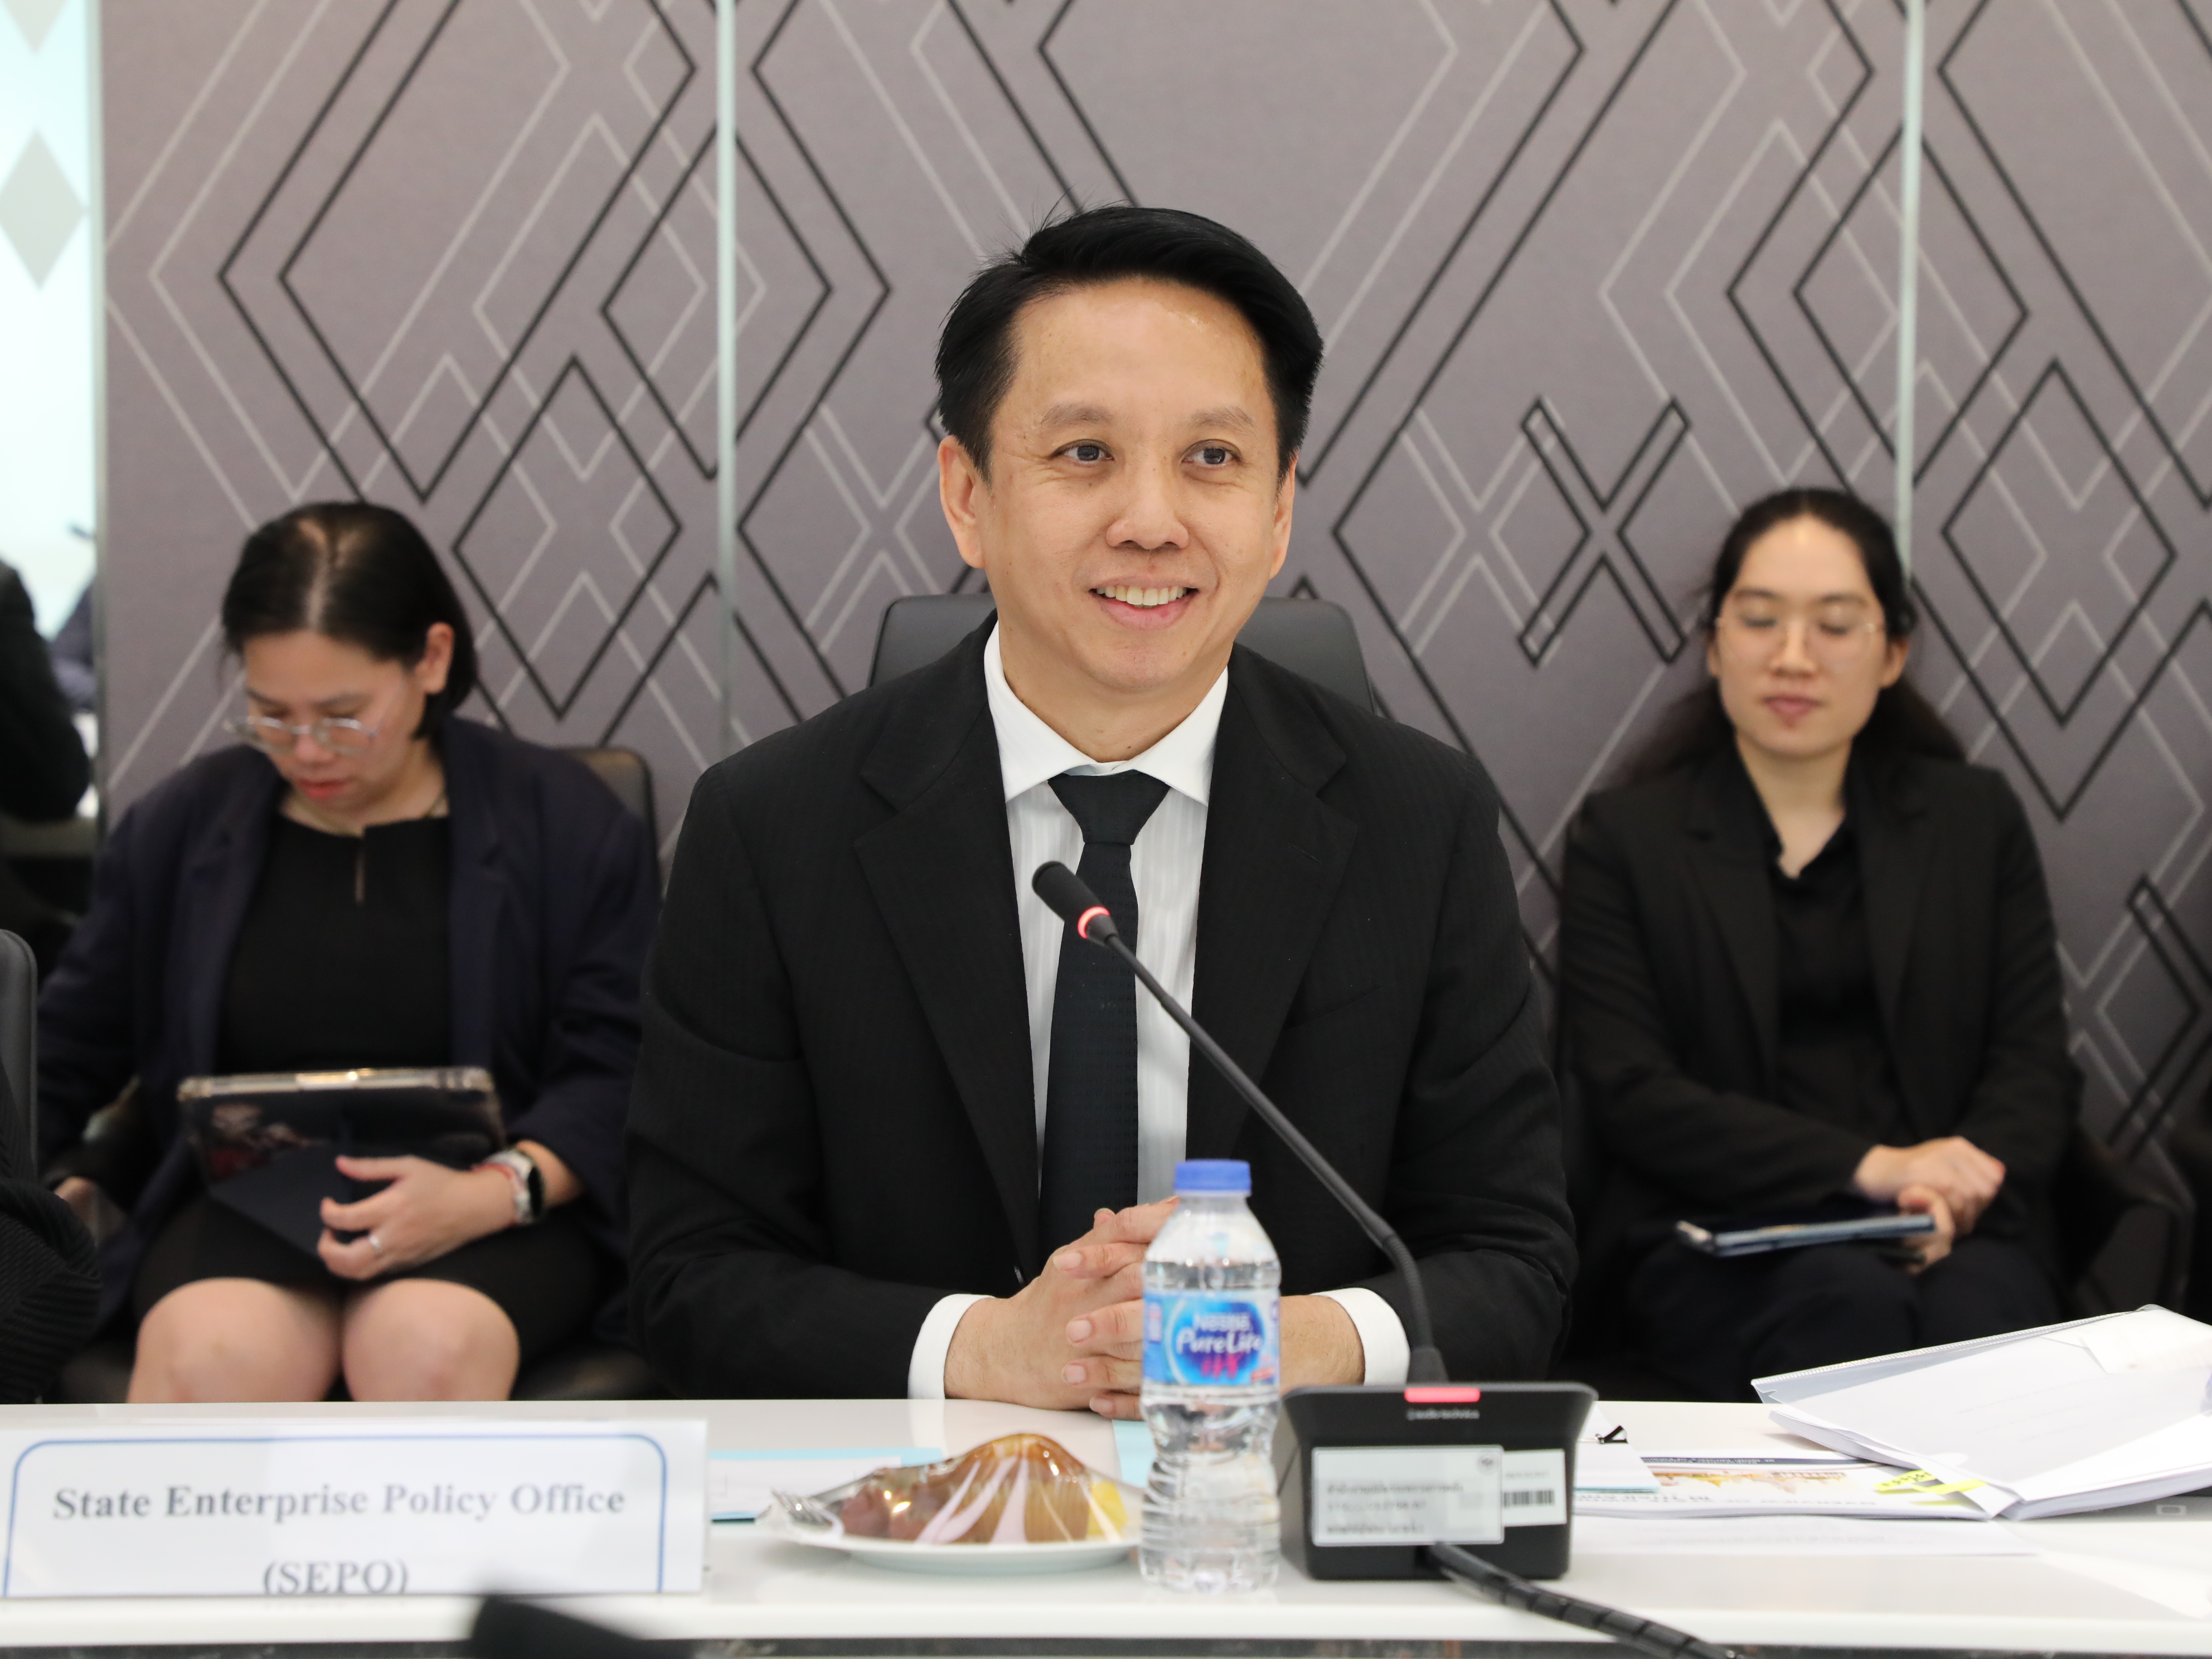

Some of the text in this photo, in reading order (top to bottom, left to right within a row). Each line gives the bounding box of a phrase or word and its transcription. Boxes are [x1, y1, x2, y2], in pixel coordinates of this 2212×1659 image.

[54, 1483, 625, 1524] State Enterprise Policy Office
[263, 1558, 409, 1594] (SEPO)
